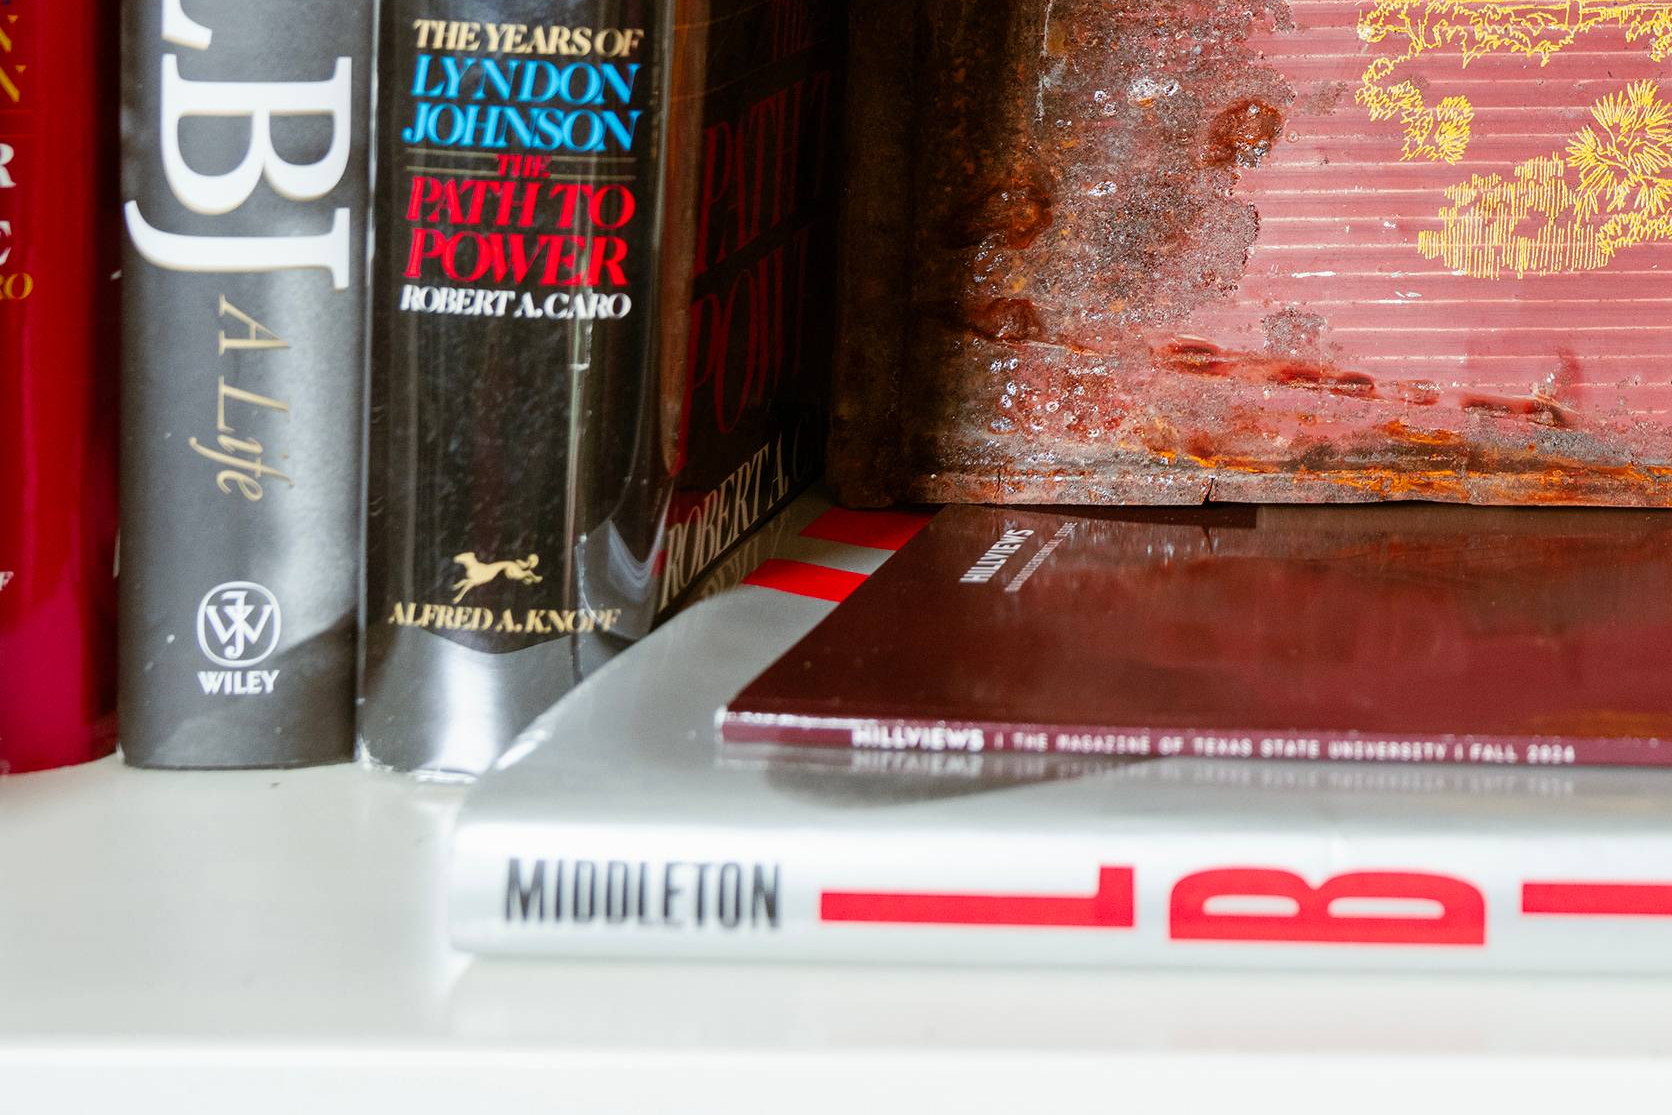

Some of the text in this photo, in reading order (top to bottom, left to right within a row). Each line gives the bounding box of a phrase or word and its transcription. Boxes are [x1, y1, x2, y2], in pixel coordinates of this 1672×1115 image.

[412, 18, 645, 58] THE YEARS OF
[410, 54, 641, 105] LYNDON
[401, 101, 643, 152] JOHNSON
[496, 152, 550, 179] THE
[405, 175, 637, 231] PATH TO
[403, 227, 629, 287] POWER
[400, 284, 633, 320] ROBERT A. CARO
[188, 293, 295, 503] A Life
[959, 527, 1034, 584] HILLVIEWS
[387, 600, 494, 631] ALFRED
[494, 607, 523, 634] A.
[197, 669, 281, 696] WILEY
[1192, 736, 1253, 758] TEXAS
[1259, 737, 1321, 759] STATE
[1327, 739, 1448, 763] UNIVERSITY
[1469, 742, 1519, 764] FALL
[504, 856, 783, 932] MIDDLETON
